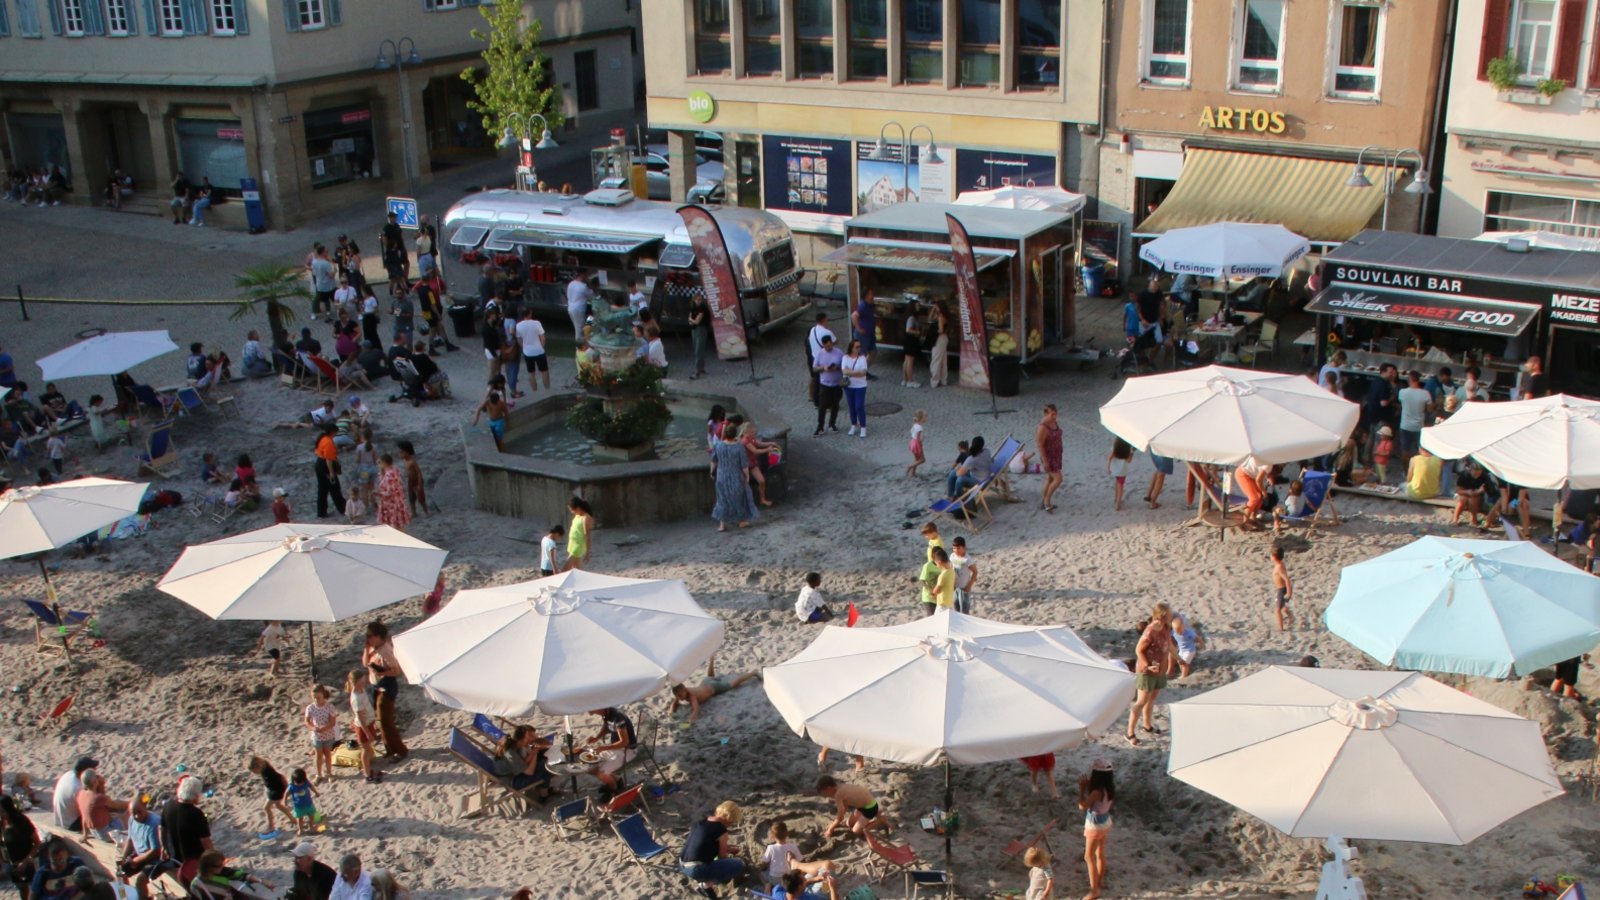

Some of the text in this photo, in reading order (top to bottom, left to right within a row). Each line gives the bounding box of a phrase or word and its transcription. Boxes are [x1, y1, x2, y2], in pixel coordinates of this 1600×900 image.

[689, 96, 708, 111] bio
[1198, 105, 1286, 134] ARTOS
[1173, 262, 1216, 274] Ensinger
[1230, 264, 1272, 275] Ensinger
[1336, 267, 1462, 293] SOUVLAKI BAR
[1551, 294, 1600, 313] MEZE
[1328, 300, 1391, 312] GREEK
[1389, 304, 1461, 319] STREET
[1458, 310, 1516, 326] FOOD
[1550, 310, 1599, 324] AKADEMIE
